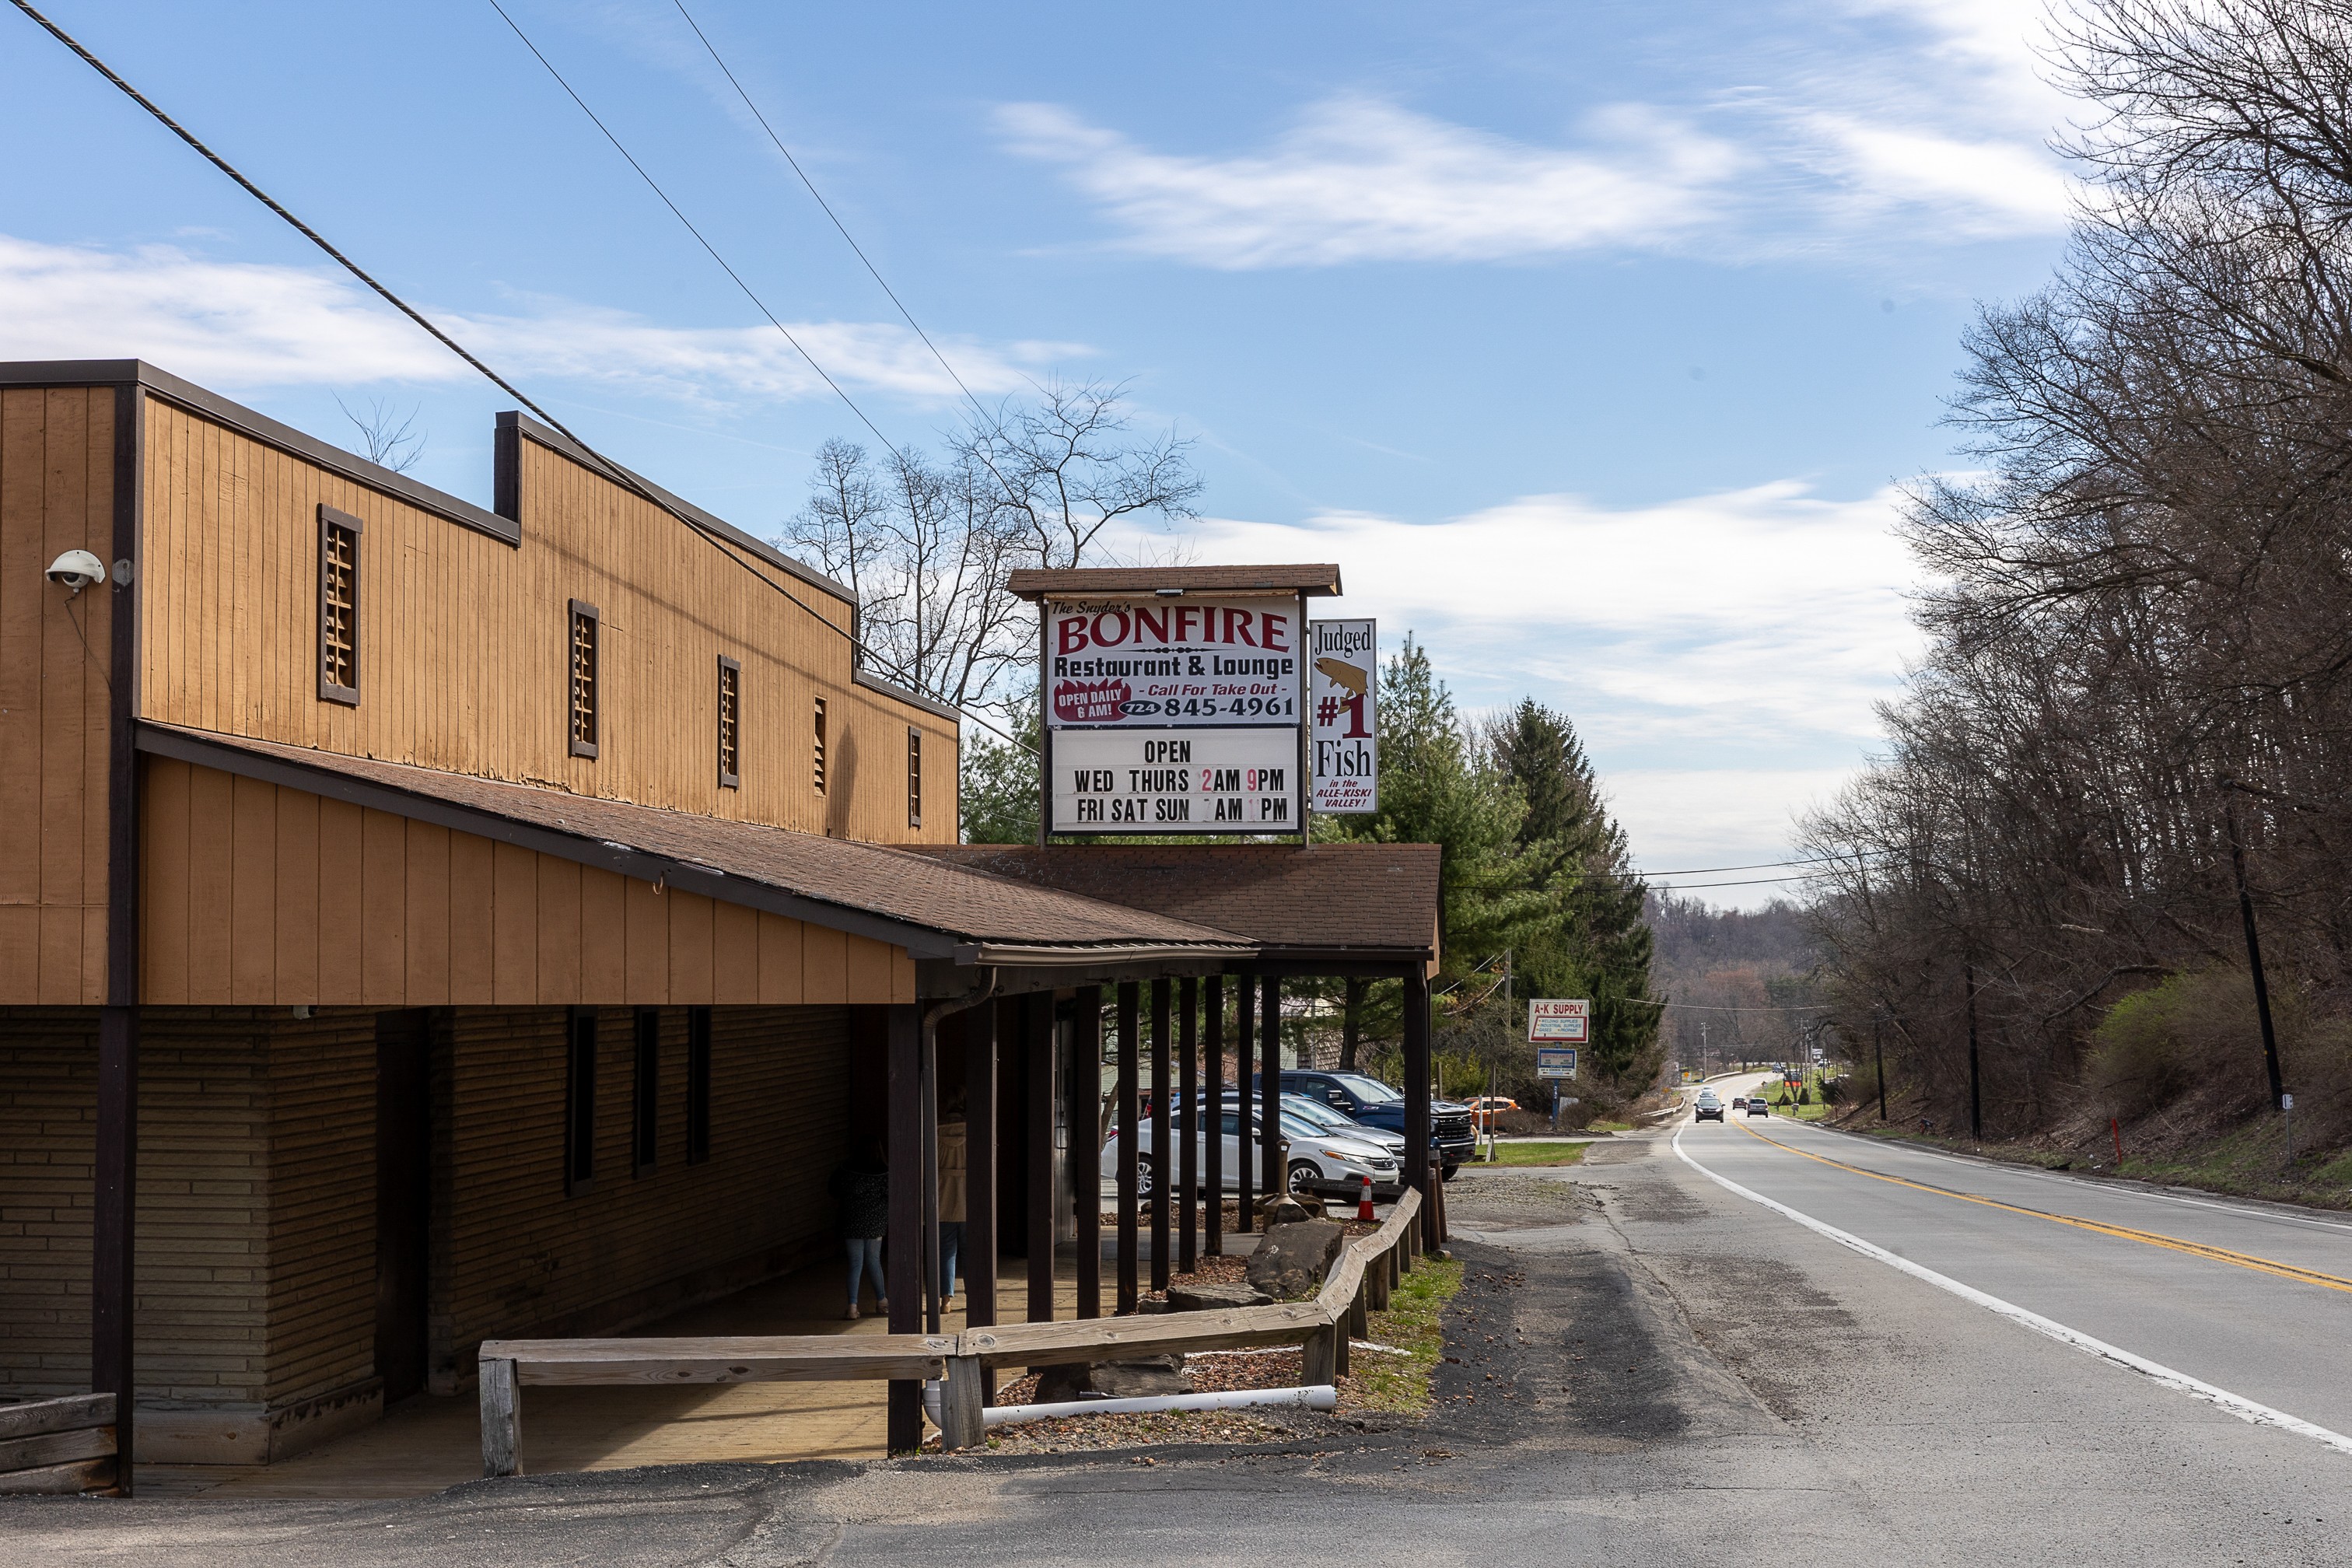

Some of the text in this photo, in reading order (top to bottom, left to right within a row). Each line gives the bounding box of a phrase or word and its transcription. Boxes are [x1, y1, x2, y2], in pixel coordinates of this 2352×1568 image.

[1052, 600, 1131, 616] The Snyder's
[1058, 606, 1290, 656] BONFIRE
[1314, 624, 1371, 659] Judged
[1055, 655, 1293, 681] Restaurant & Lounge
[1059, 688, 1122, 707] OPEN DAILY
[1148, 684, 1179, 696] Call
[1181, 684, 1207, 695] For
[1212, 683, 1247, 695] Take
[1250, 683, 1278, 695] Out
[1077, 704, 1112, 719] 6 AM!
[1125, 697, 1293, 716] 724 845-4961
[1145, 740, 1191, 763] OPEN
[1315, 740, 1372, 777] Fish
[1074, 769, 1114, 792] WED
[1129, 768, 1189, 792] THURS
[1329, 779, 1358, 788] in the
[1316, 789, 1373, 798] ALLE-KISKI
[1077, 798, 1104, 821] FRI
[1111, 798, 1148, 821] SAT
[1155, 797, 1189, 821] SUN
[1535, 1003, 1584, 1014] A-K SUPPLY
